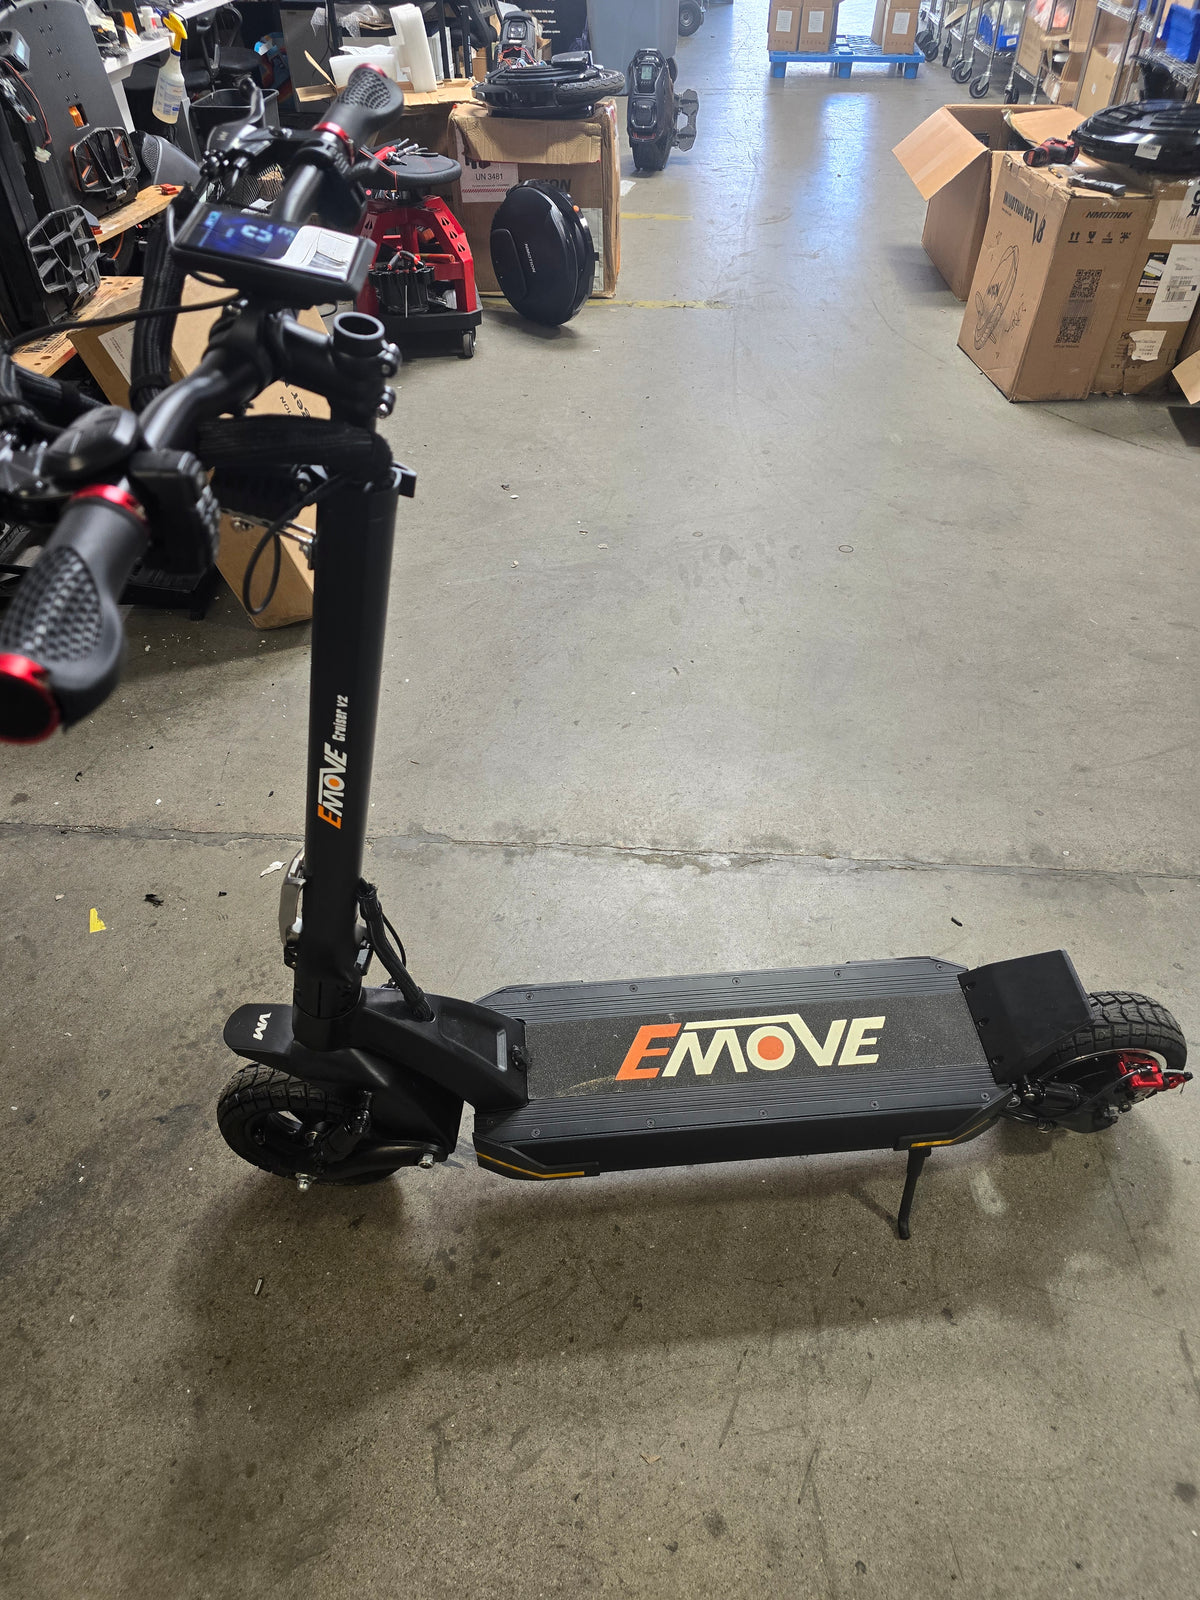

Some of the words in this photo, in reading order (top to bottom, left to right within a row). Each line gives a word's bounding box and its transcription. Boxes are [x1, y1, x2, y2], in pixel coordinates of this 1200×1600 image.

[332, 708, 348, 742] Cruiser
[336, 694, 349, 707] V2
[317, 742, 347, 829] EMOVE
[615, 1013, 886, 1081] EMOVE
